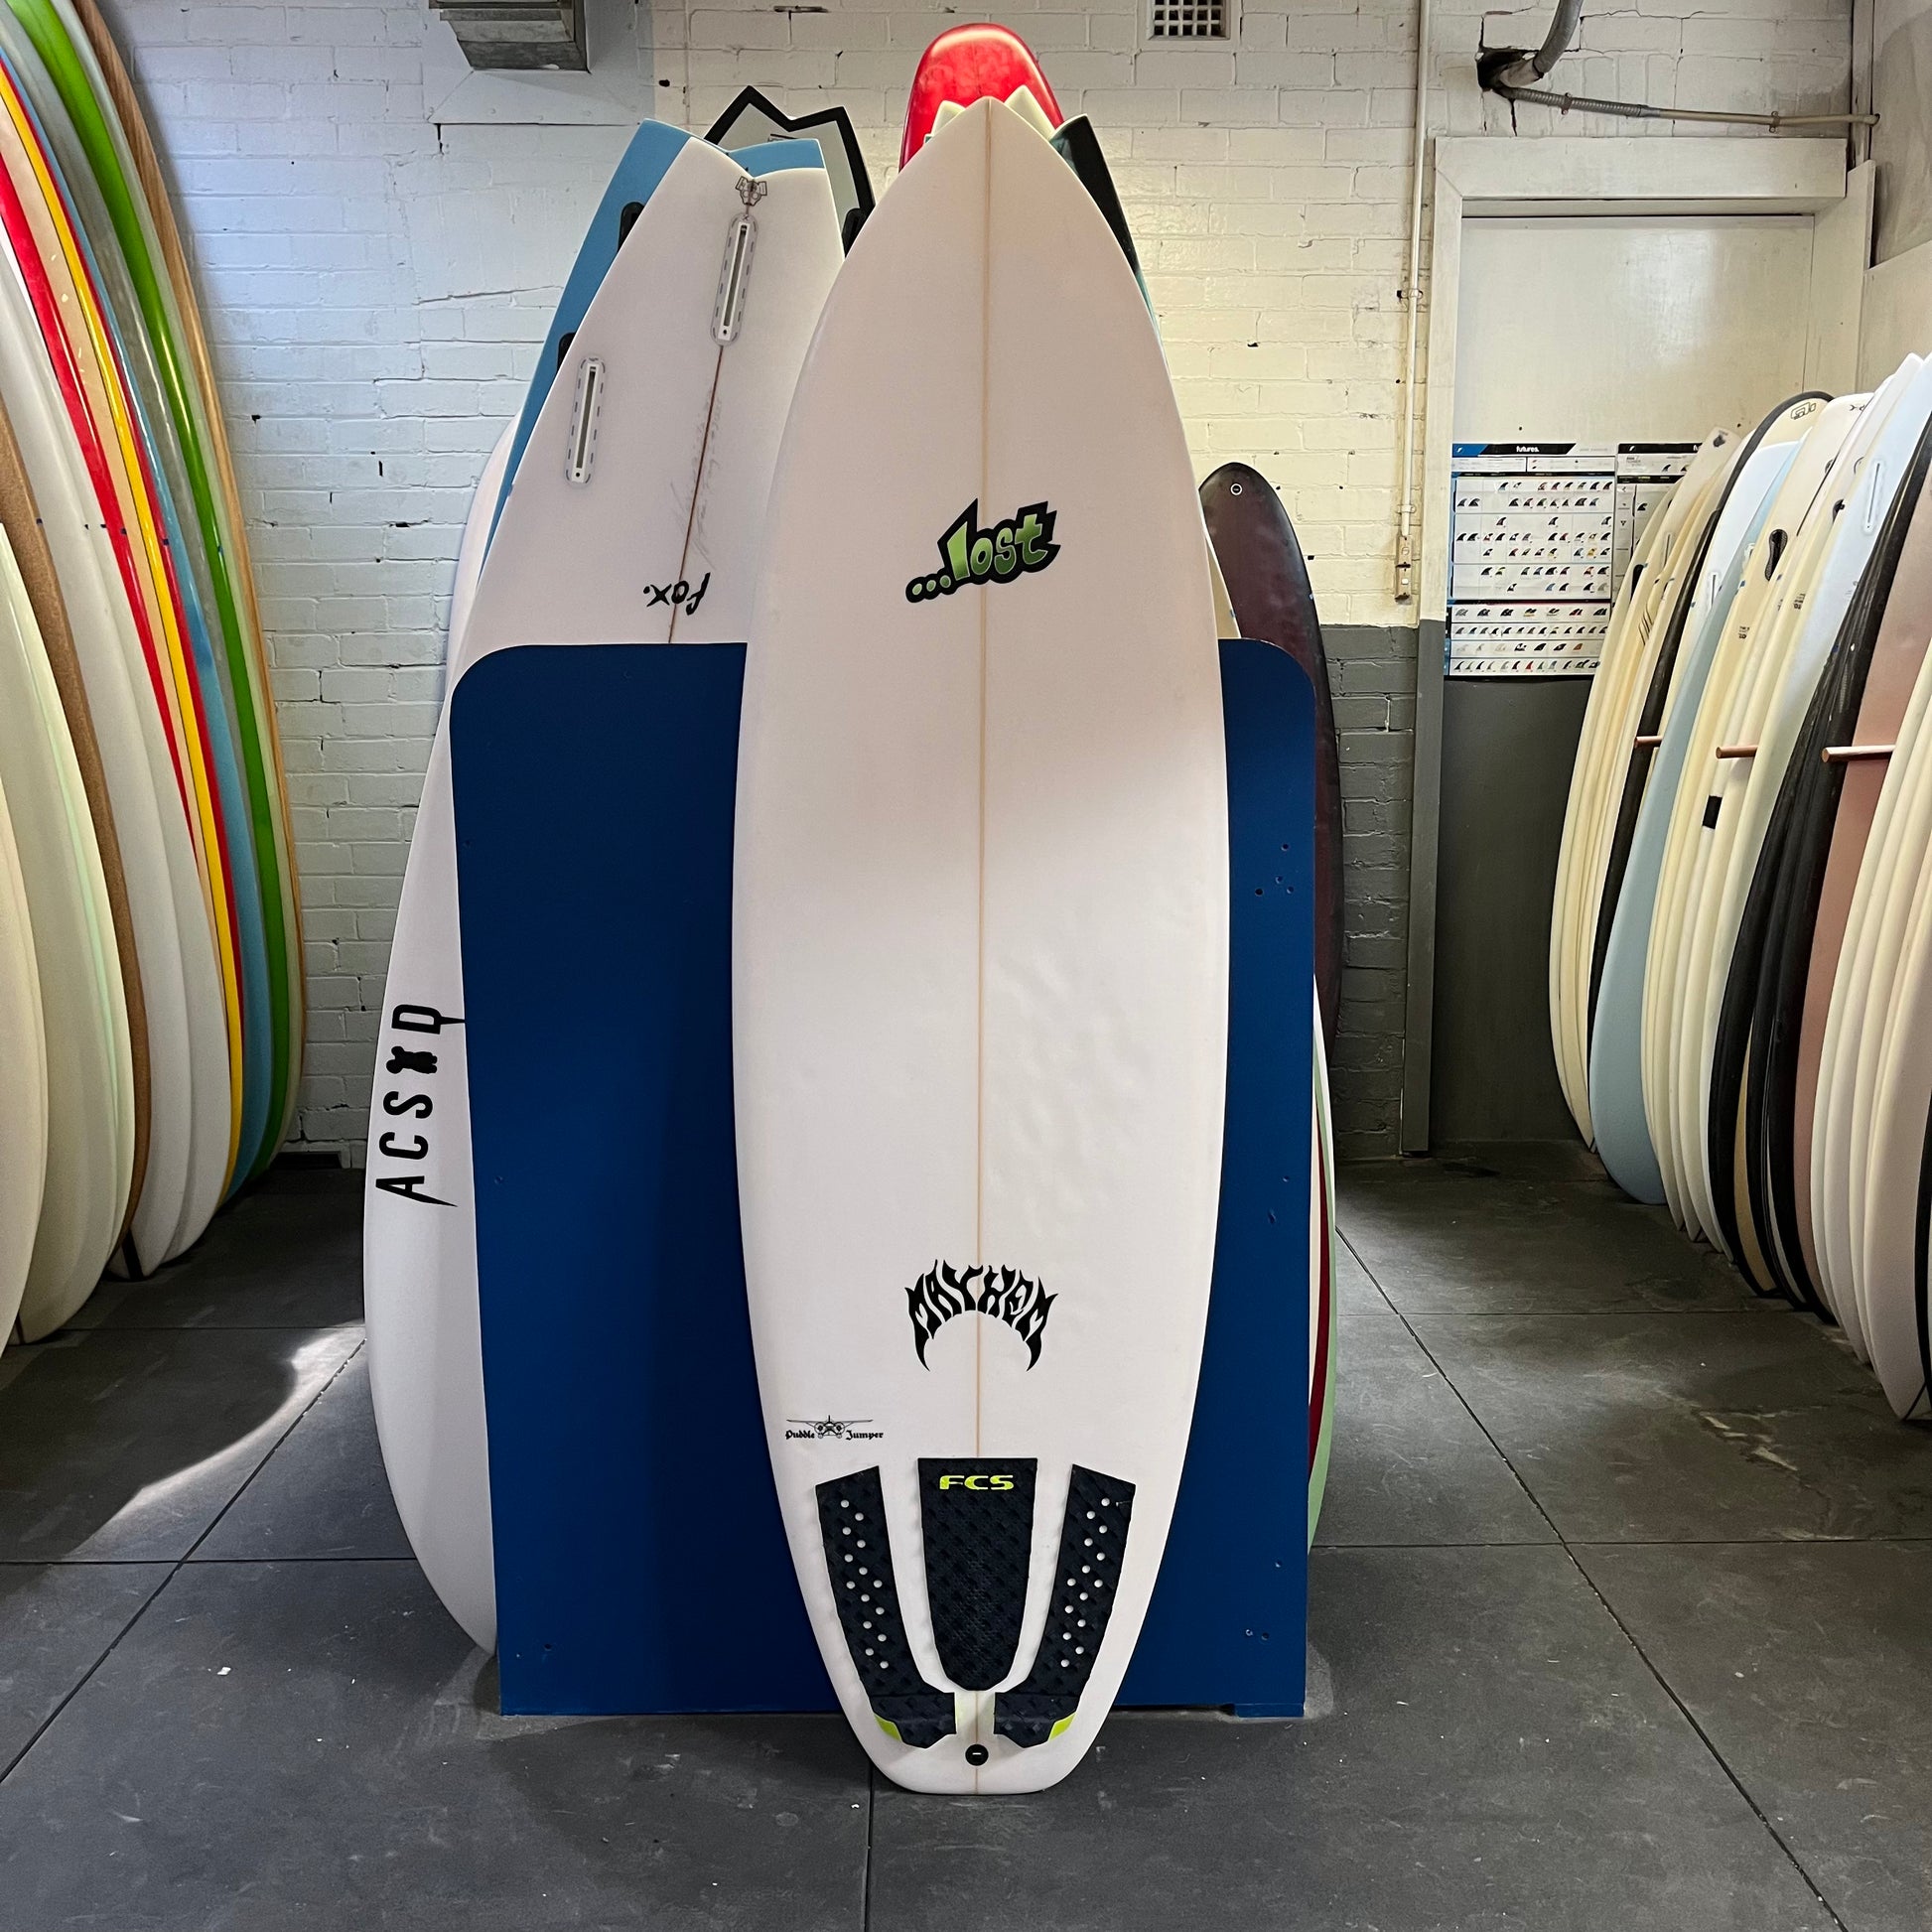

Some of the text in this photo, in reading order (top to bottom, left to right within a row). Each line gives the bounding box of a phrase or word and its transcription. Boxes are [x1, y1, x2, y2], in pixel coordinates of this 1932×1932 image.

[904, 1259, 1059, 1372] MAYHEM
[785, 1430, 884, 1441] Puddle Jumper
[939, 1474, 1015, 1490] FCS
